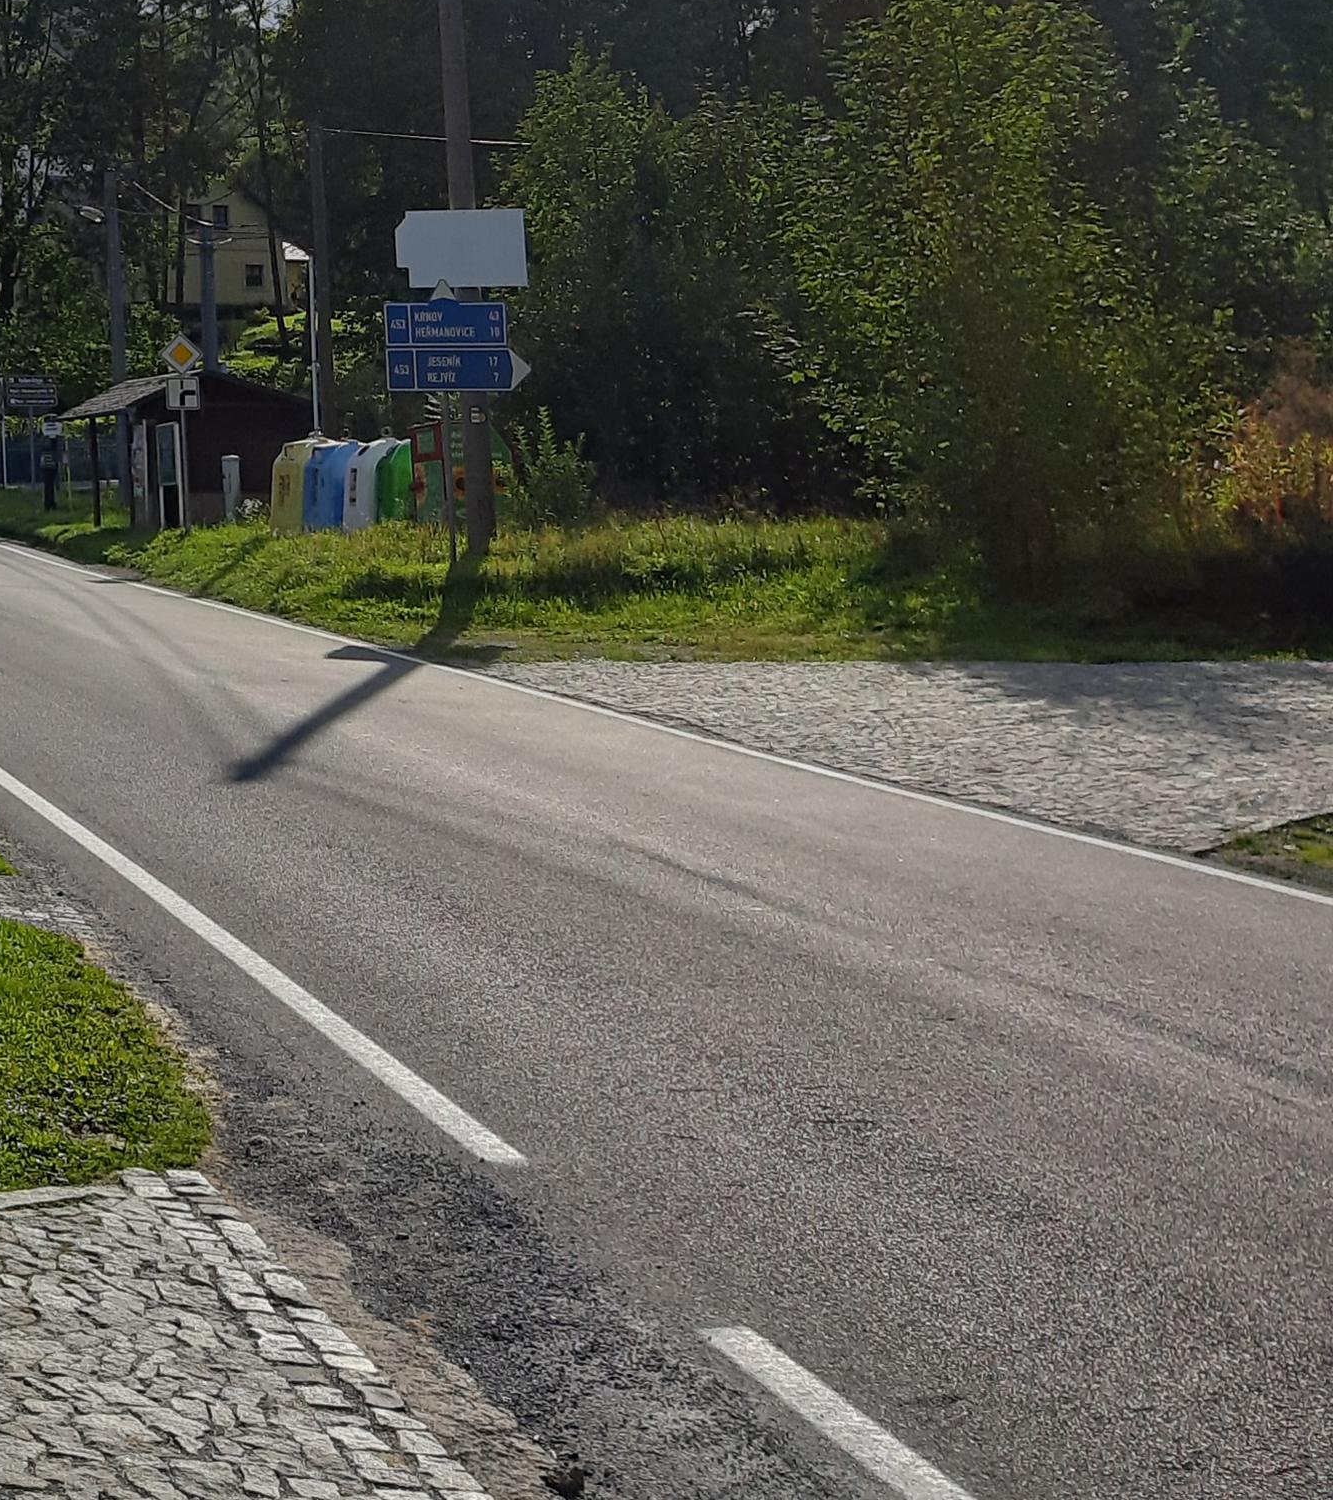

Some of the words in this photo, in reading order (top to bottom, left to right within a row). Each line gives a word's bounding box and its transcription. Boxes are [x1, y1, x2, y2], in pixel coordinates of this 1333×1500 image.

[414, 312, 443, 323] KRNOV
[488, 310, 500, 321] 43
[415, 325, 476, 338] HEŘMANOVICE
[427, 354, 461, 367] JESENÍK
[488, 356, 498, 367] 17
[427, 371, 456, 383] REJVÍZ
[493, 372, 499, 382] 7
